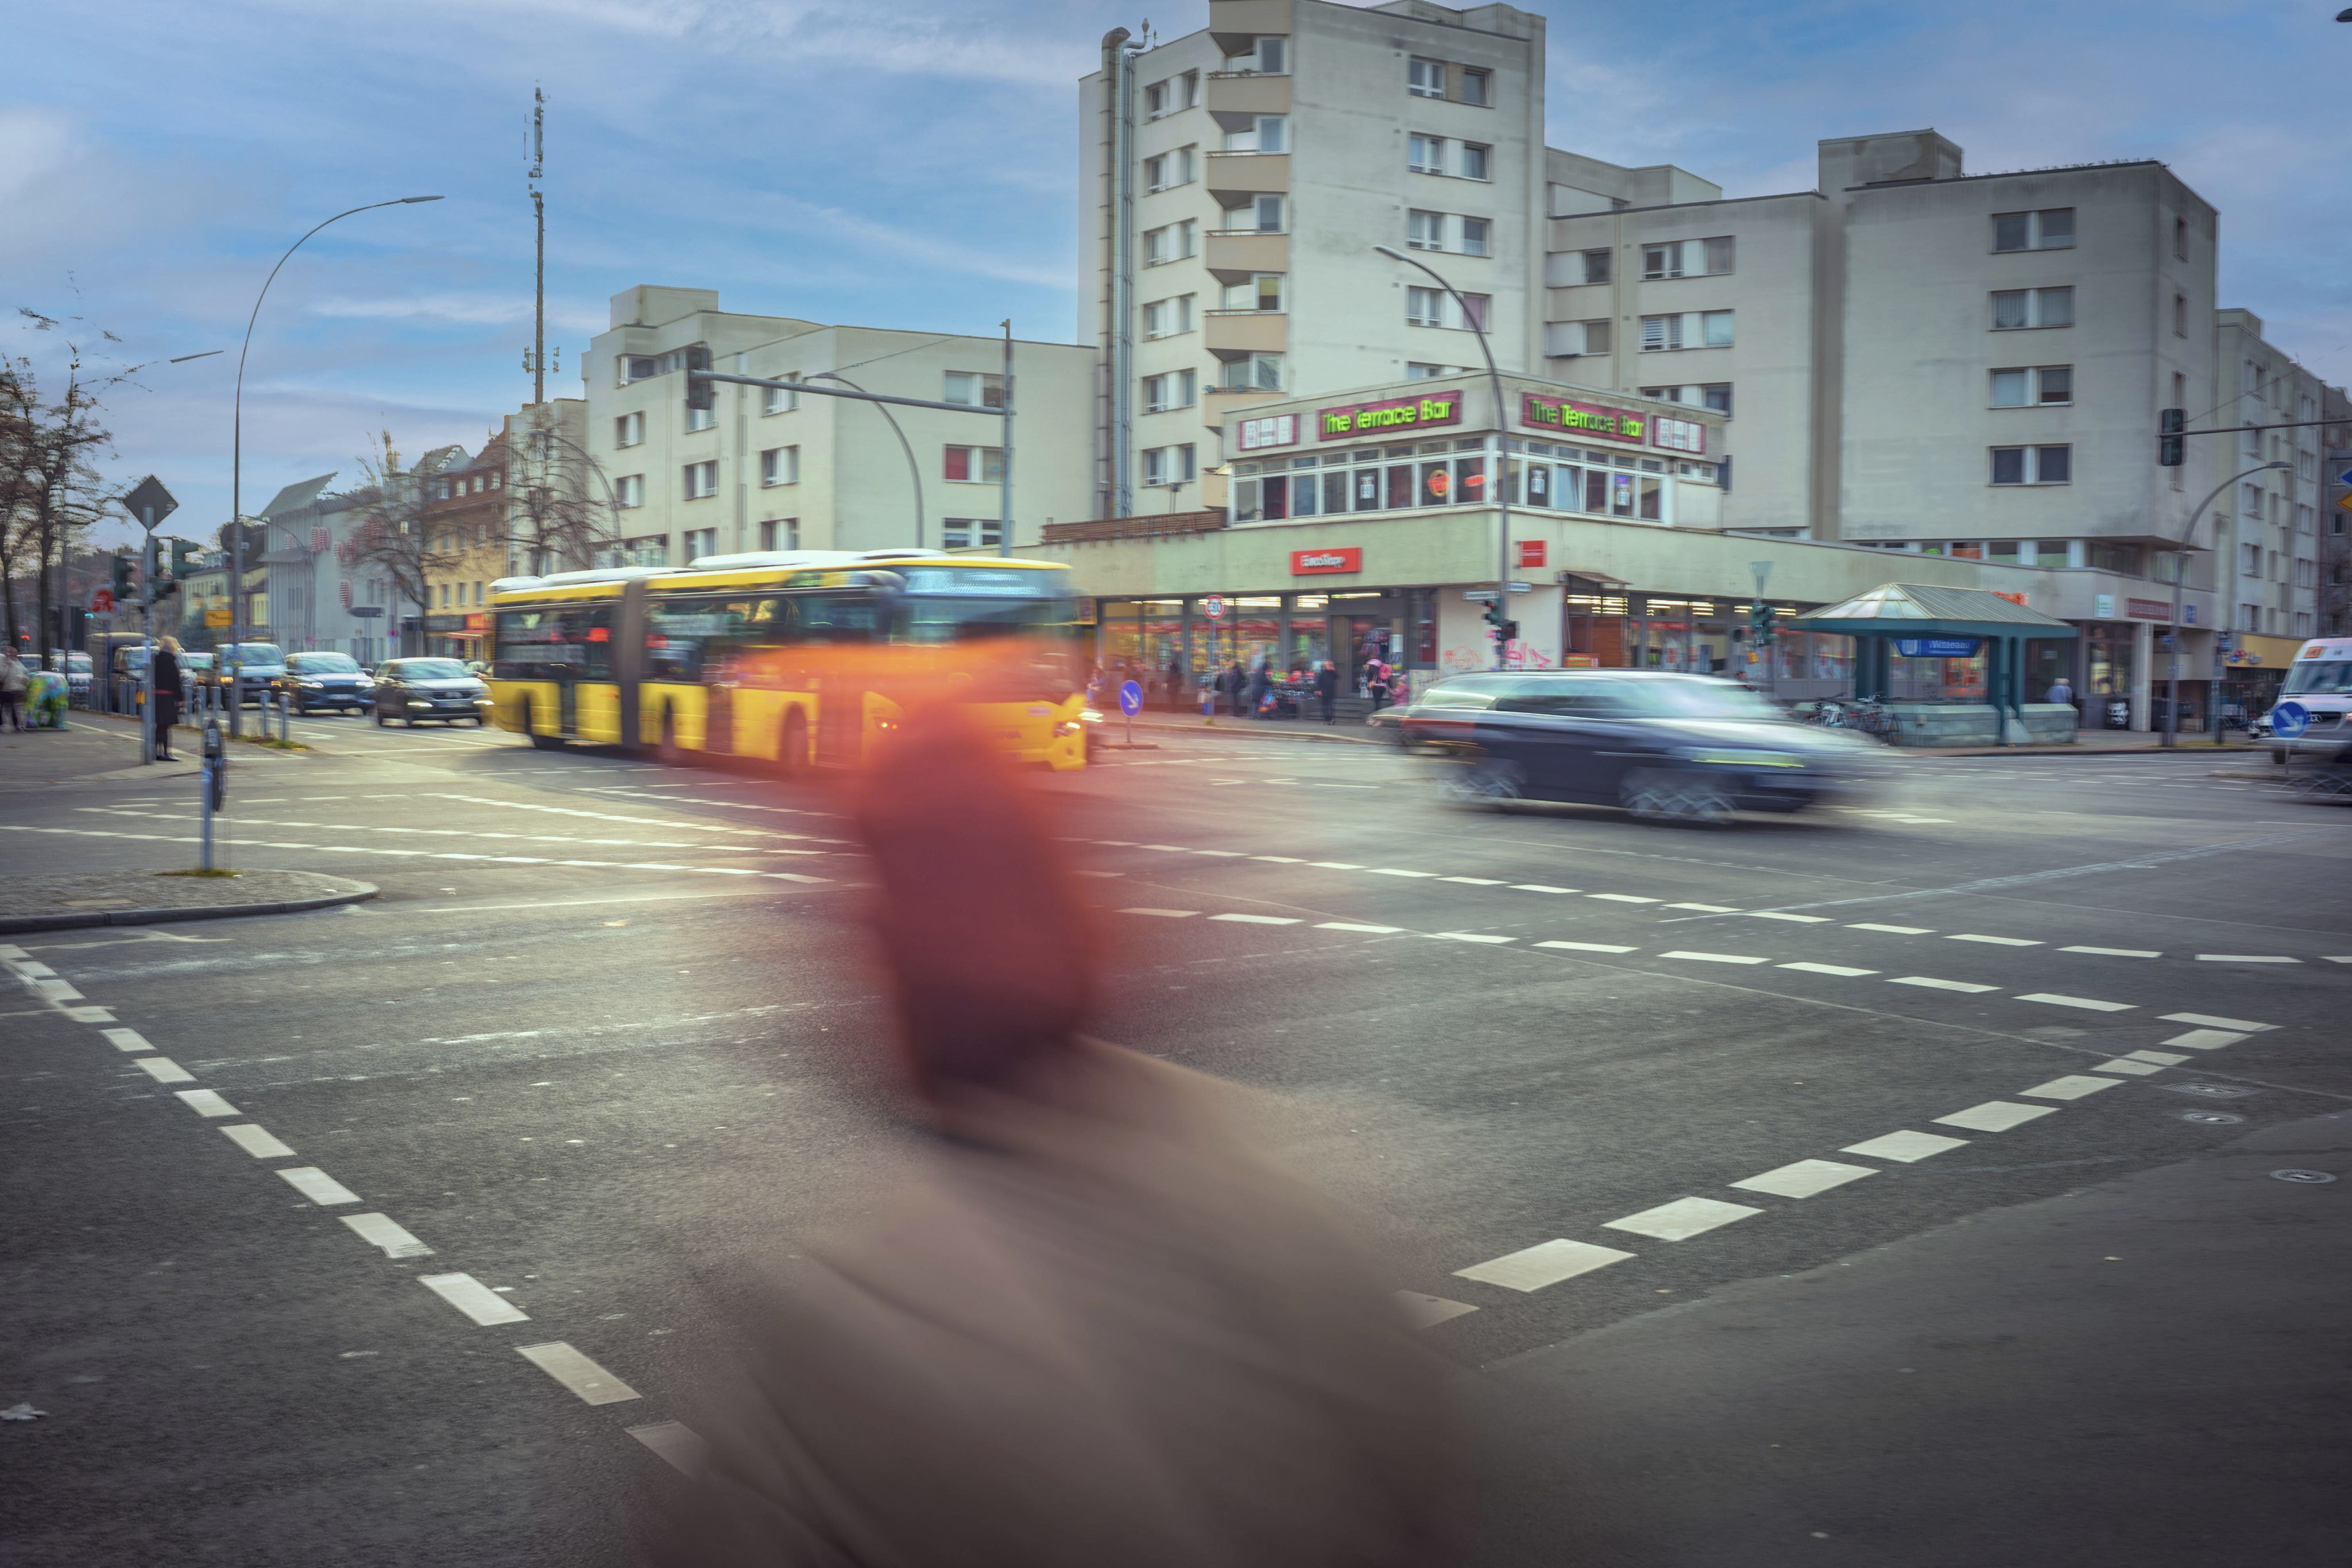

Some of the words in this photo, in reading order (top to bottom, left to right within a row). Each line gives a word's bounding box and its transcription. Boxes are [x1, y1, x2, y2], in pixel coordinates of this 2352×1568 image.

[1322, 413, 1351, 433] The
[1354, 406, 1417, 429] Terrace
[1420, 399, 1452, 421] Bar
[1530, 399, 1559, 423] The
[1560, 404, 1616, 433] Terrace
[1619, 415, 1644, 438] Bar
